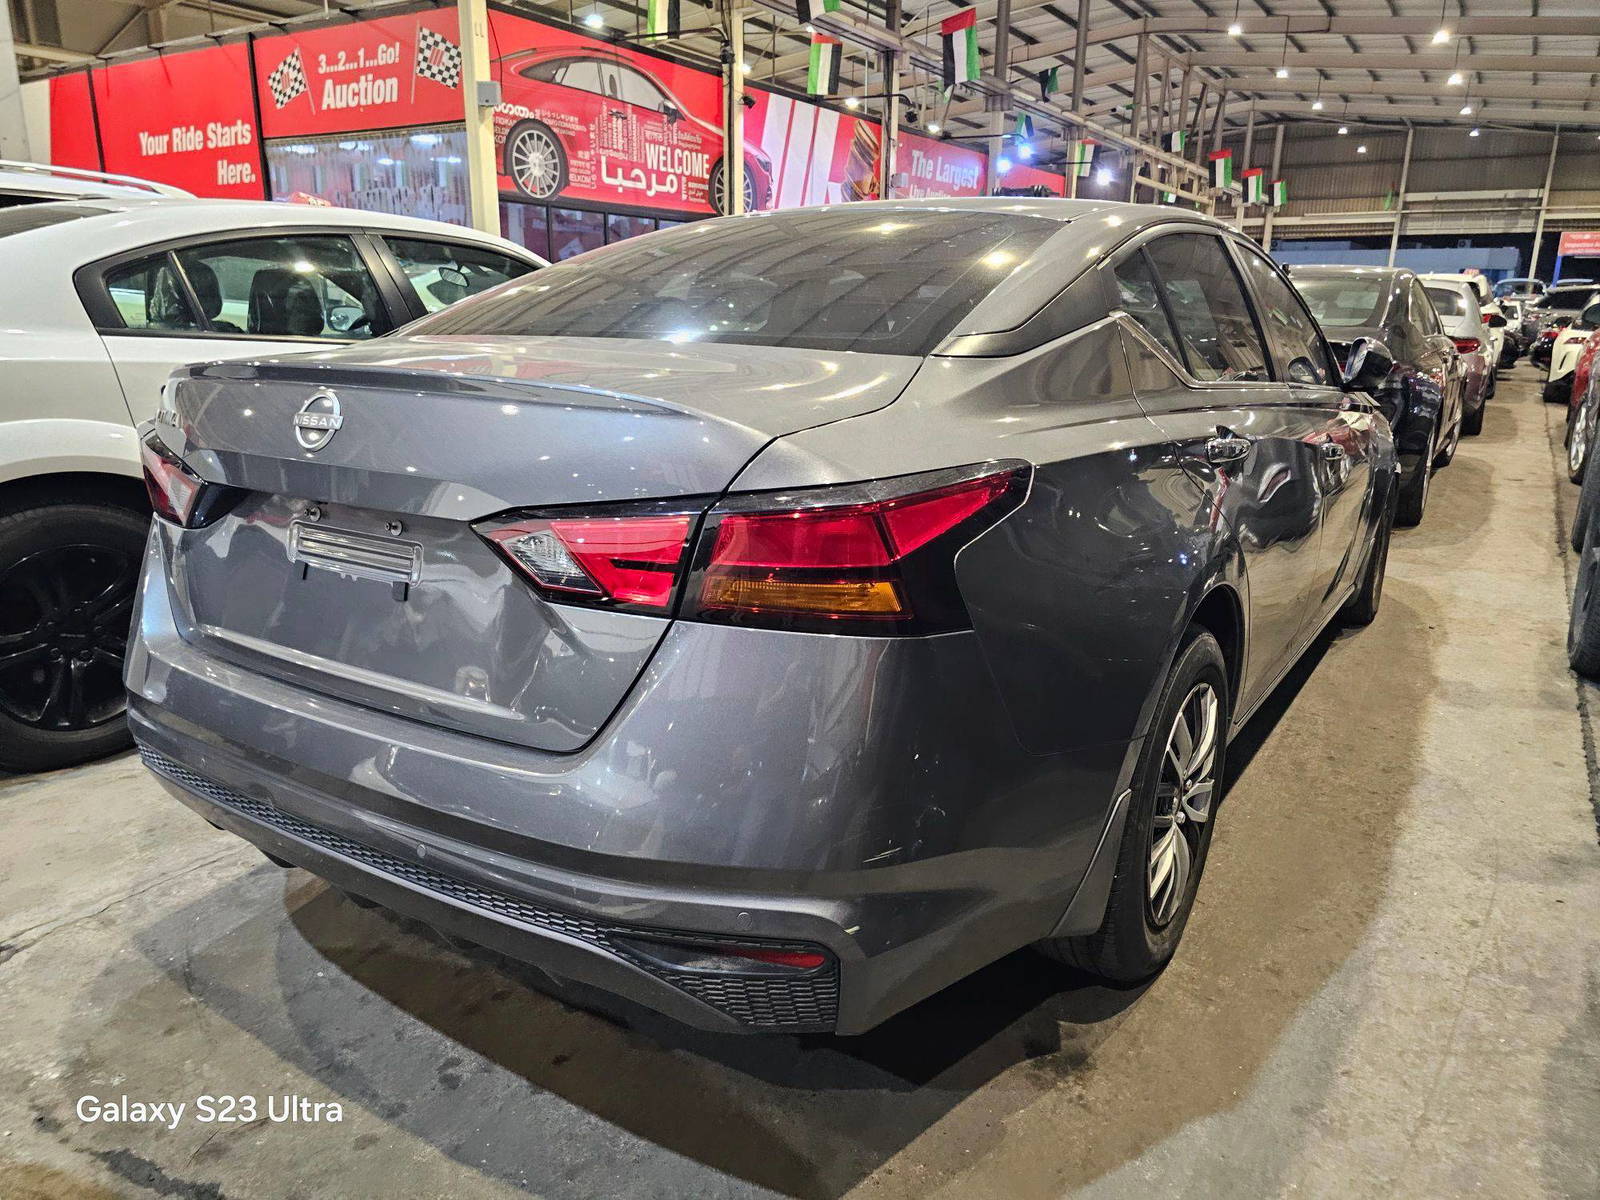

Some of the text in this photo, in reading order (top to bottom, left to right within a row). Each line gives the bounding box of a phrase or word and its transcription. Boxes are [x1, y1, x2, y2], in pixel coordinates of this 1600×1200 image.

[318, 41, 400, 74] 3...2...1...Go!
[321, 73, 399, 110] Auction
[139, 119, 252, 156] Your Ride Starts
[217, 159, 256, 185] Here.
[600, 155, 679, 197] مرحبا
[645, 142, 710, 179] WELCOME
[911, 149, 934, 180] The
[935, 156, 979, 192] Largest
[293, 414, 342, 429] NISSAN
